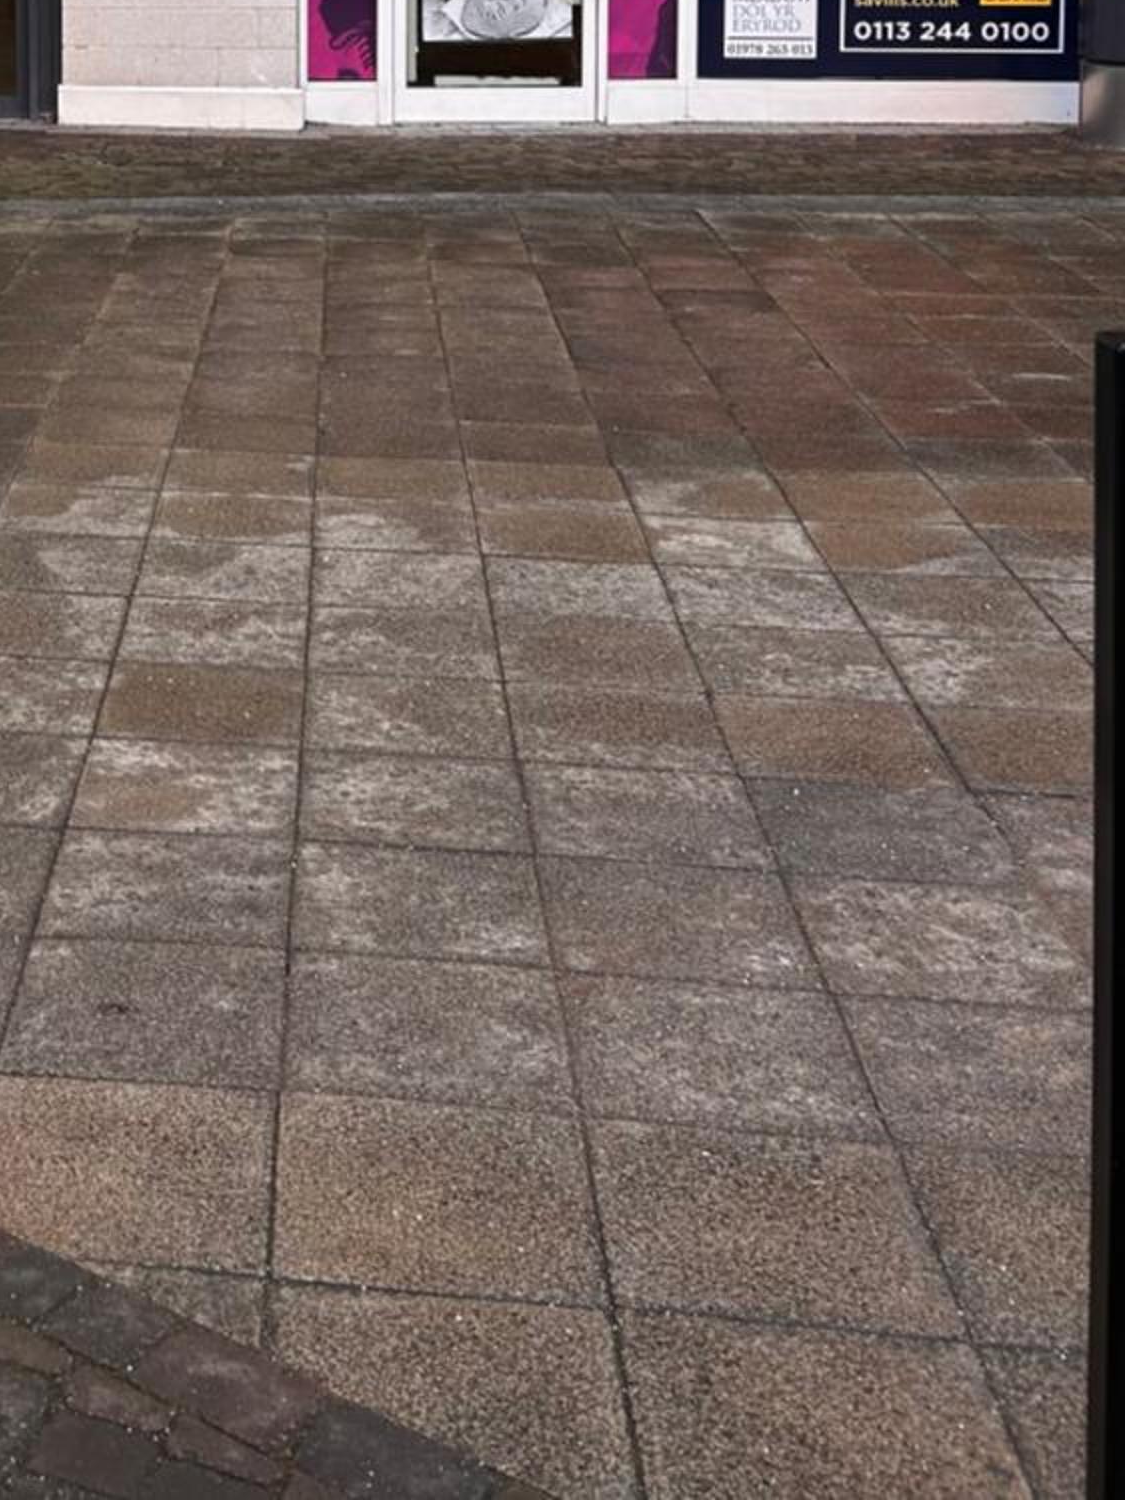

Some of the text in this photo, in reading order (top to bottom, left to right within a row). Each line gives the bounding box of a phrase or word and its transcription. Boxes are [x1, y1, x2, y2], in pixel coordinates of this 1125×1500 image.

[854, 21, 1050, 42] 0113 244 0100
